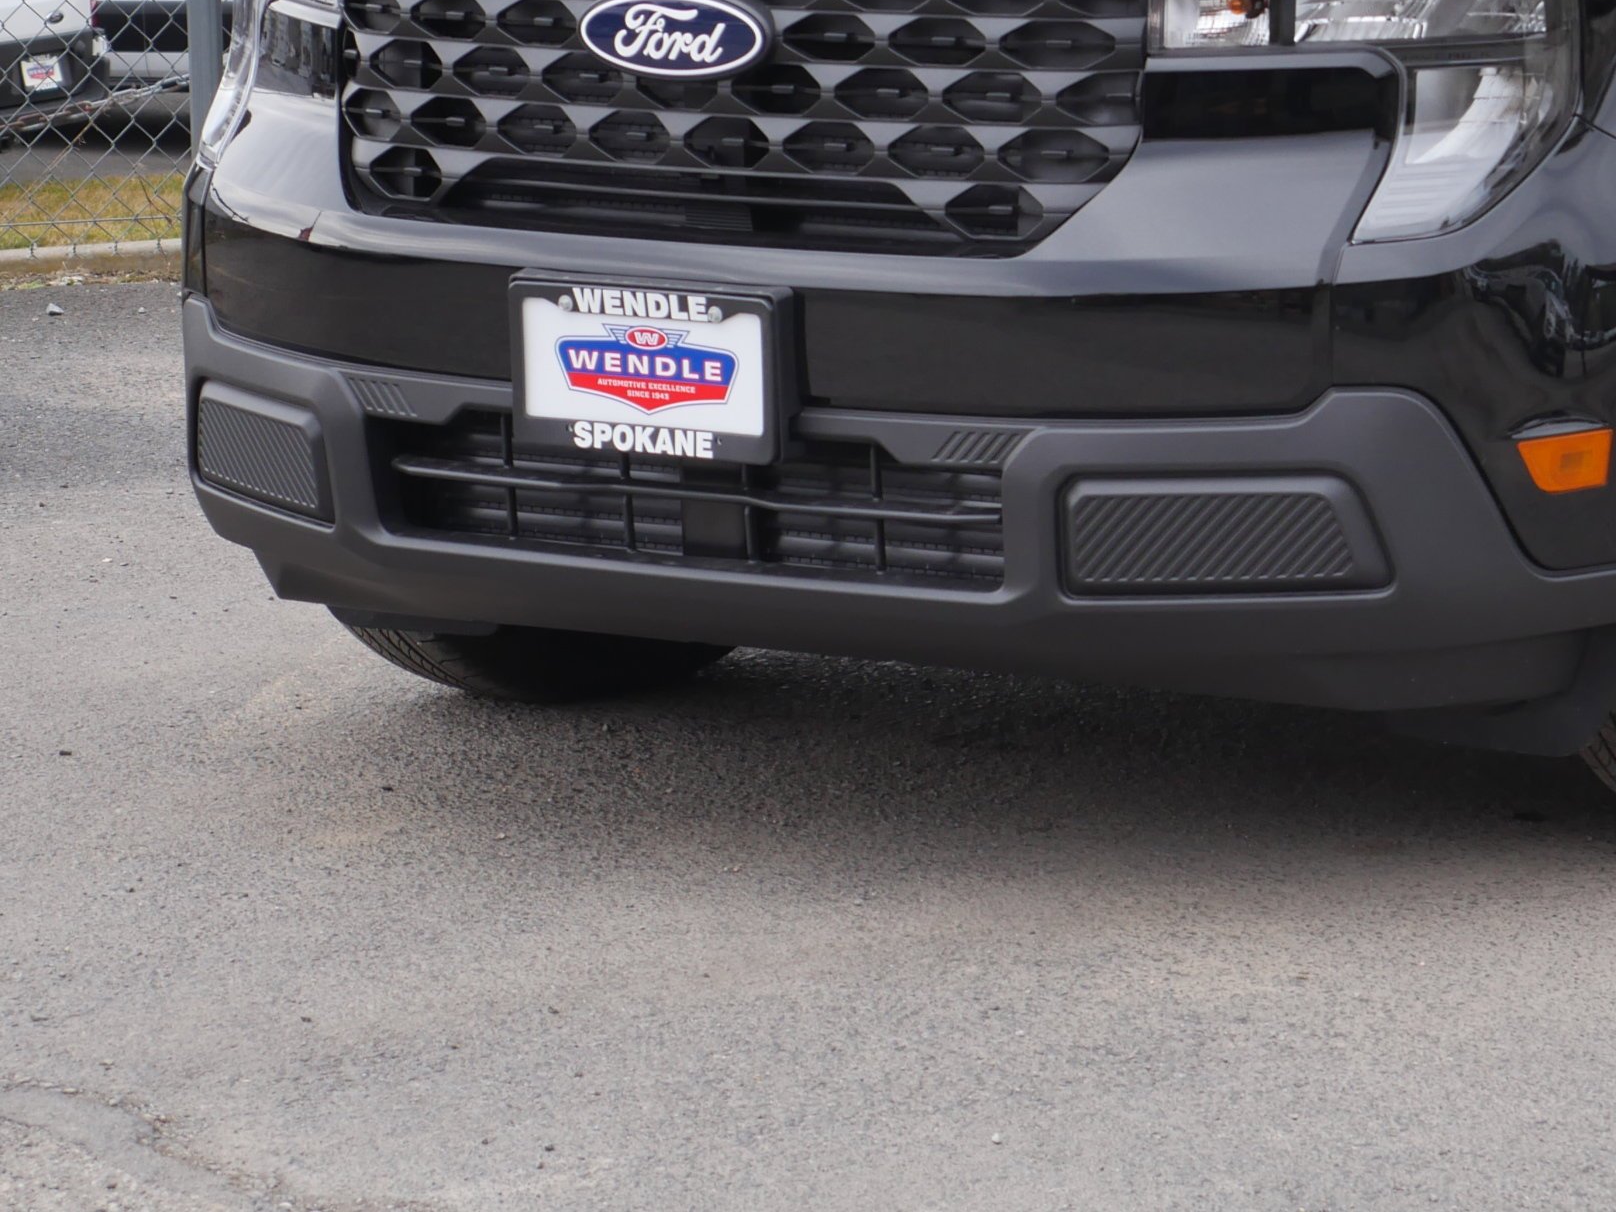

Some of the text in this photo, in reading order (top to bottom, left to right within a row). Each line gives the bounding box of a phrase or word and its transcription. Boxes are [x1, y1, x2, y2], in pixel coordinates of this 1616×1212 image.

[614, 3, 726, 63] Ford
[572, 287, 709, 322] WENDLE
[568, 348, 723, 382] WENDLE
[597, 378, 696, 394] AUTOMOTIVE EXCELLENCE
[627, 389, 650, 399] SINCE
[572, 420, 714, 460] SPOKANE
